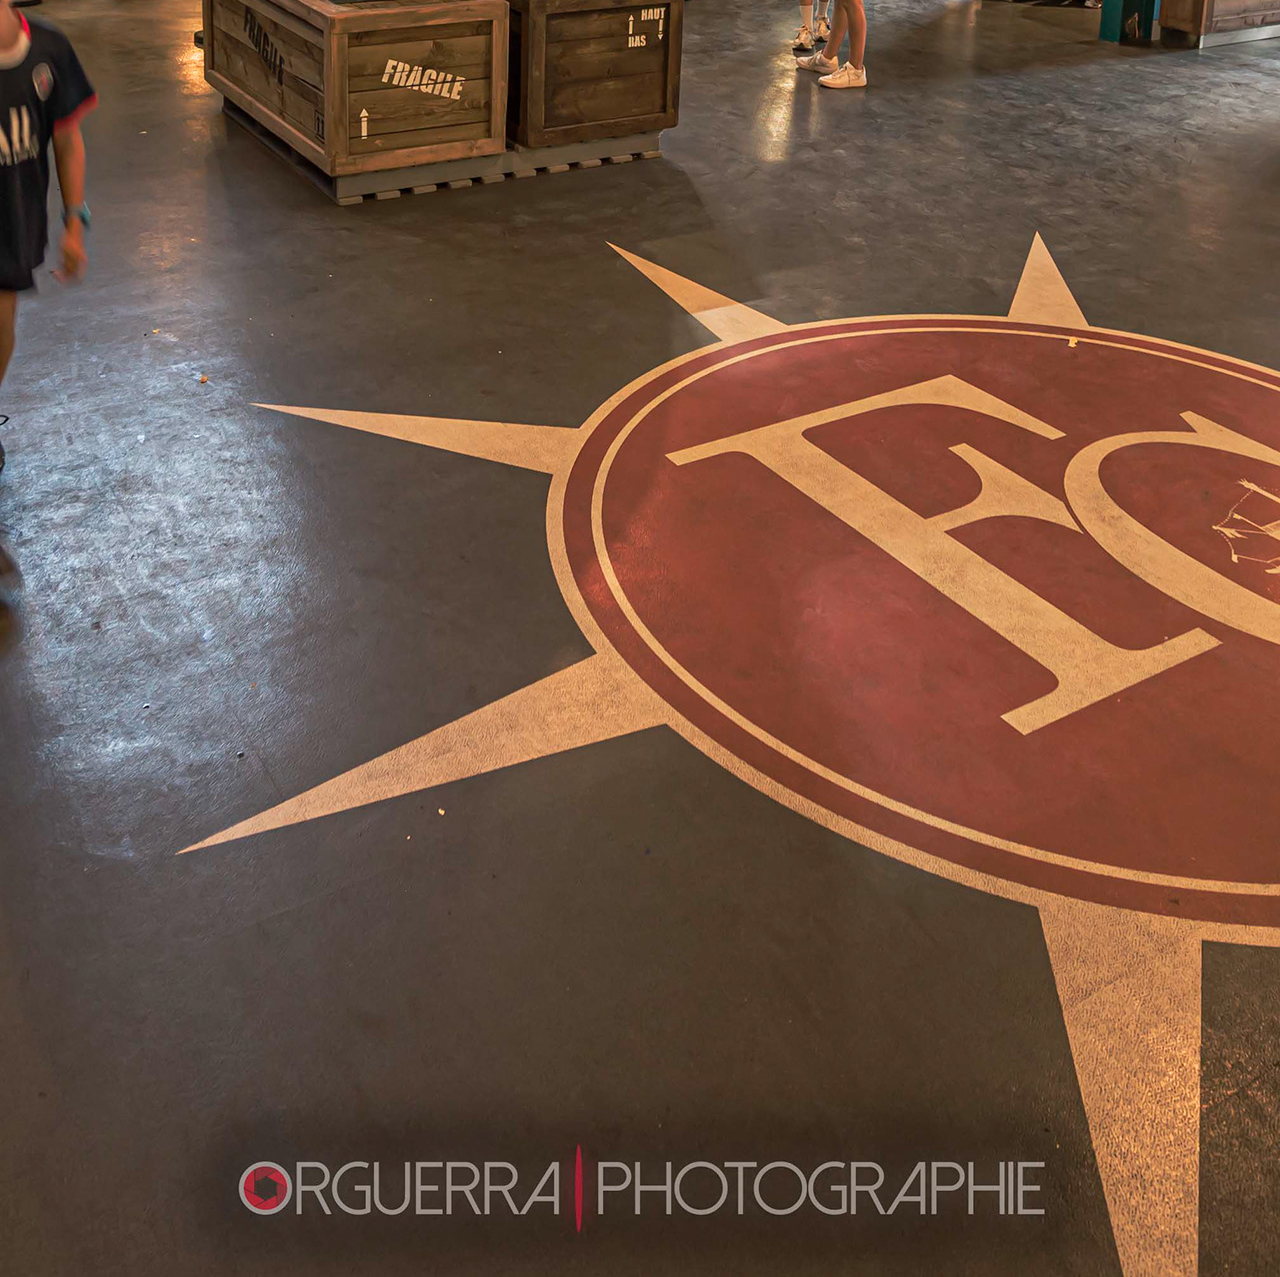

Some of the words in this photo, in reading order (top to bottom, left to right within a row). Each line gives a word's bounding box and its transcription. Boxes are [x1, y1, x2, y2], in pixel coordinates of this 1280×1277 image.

[641, 7, 666, 21] HAUT
[244, 6, 285, 86] FRAGILE
[628, 34, 647, 48] BAS
[381, 58, 467, 101] FRAGILE
